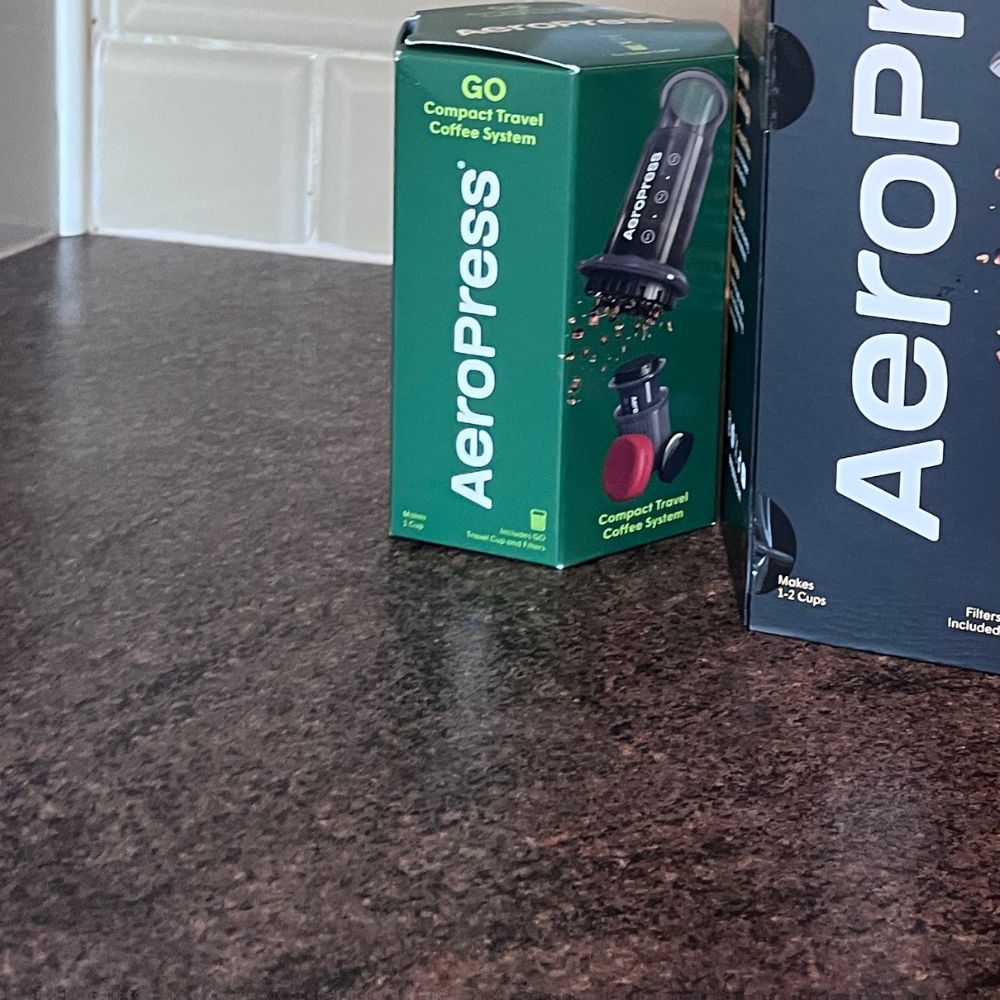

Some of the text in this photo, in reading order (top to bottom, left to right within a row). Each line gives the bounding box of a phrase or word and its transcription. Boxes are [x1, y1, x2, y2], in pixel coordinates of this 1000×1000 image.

[461, 74, 507, 102] GO
[423, 101, 544, 127] Compact Travel
[429, 121, 537, 146] Coffee System
[451, 168, 500, 510] AeroPress
[598, 491, 689, 525] Compact Travel
[603, 510, 684, 539] Coffee System
[778, 574, 815, 591] Makes
[777, 587, 827, 608] 1-2 Cups
[947, 617, 1000, 636] Included
